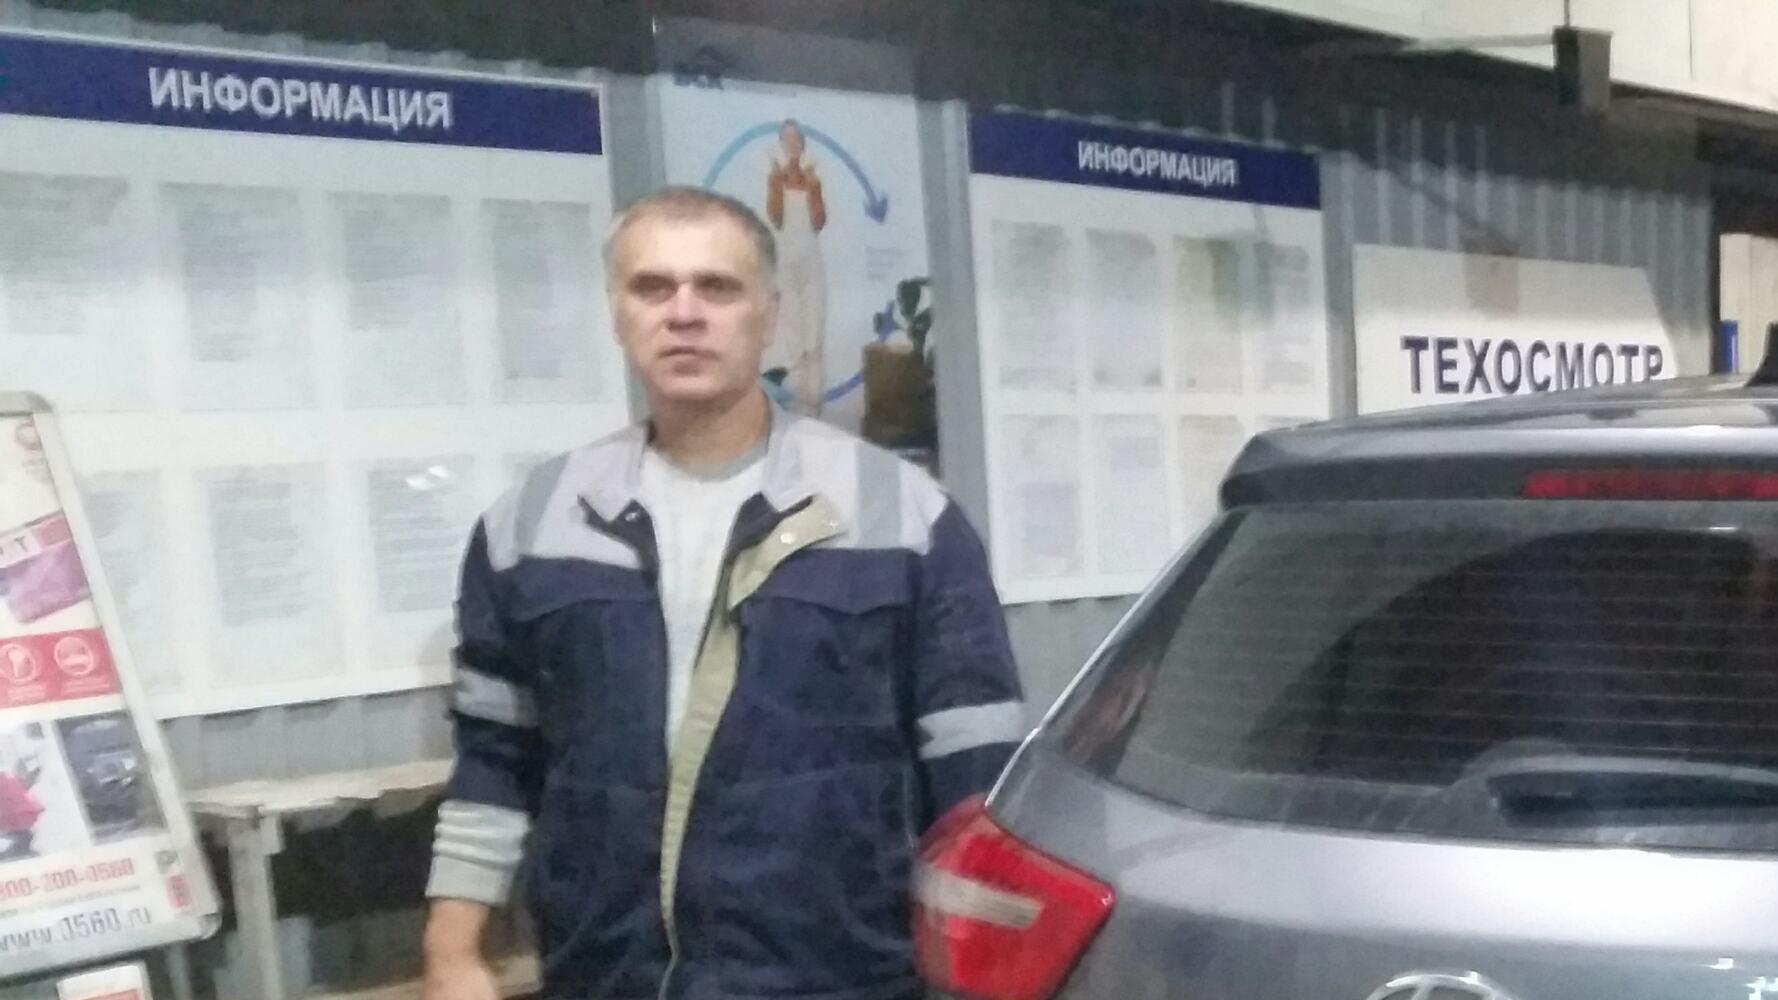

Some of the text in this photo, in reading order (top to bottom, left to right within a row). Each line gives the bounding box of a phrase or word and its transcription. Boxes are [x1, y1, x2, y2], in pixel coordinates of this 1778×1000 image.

[148, 66, 454, 134] ИНФОРМАЦИЯ
[1078, 140, 1238, 189] ИНФОРМАЦИЯ
[1400, 335, 1663, 394] ТЕХОСМОТР
